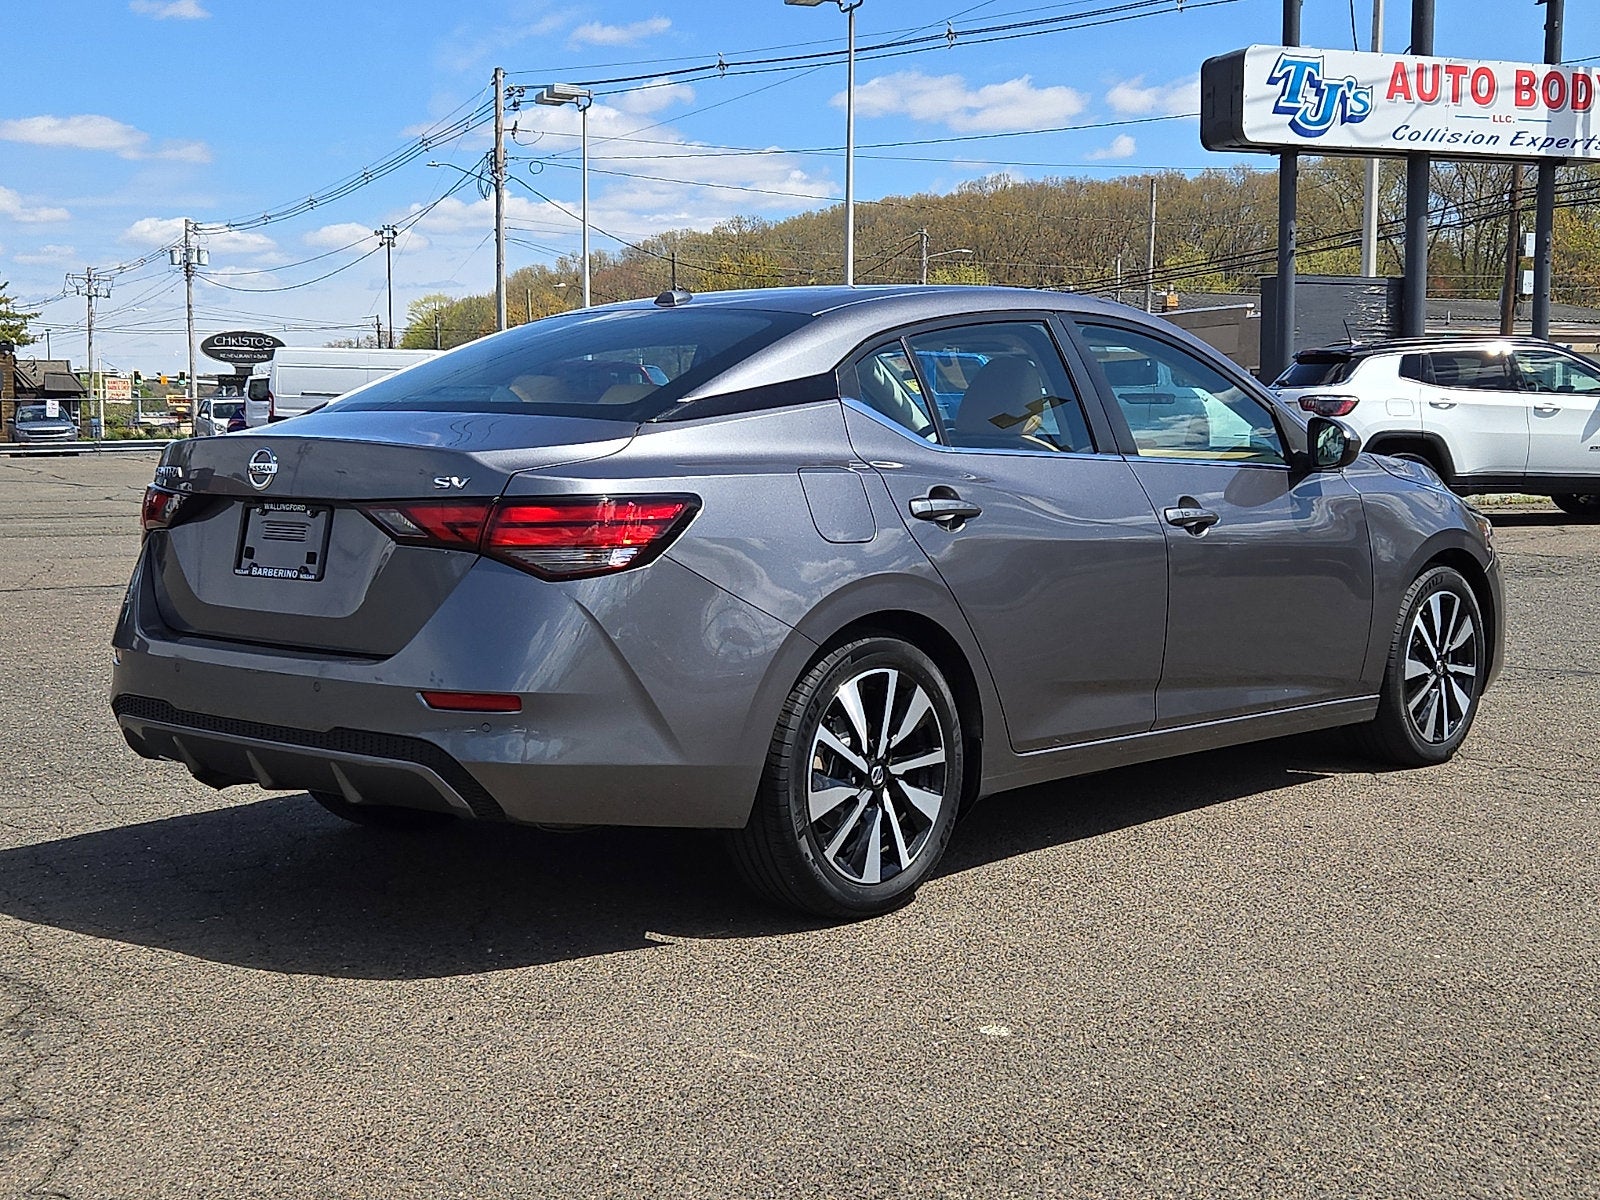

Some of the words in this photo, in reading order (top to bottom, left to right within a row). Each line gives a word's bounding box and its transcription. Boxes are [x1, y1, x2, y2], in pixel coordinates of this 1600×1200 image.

[1266, 52, 1373, 138] TJ's
[1385, 61, 1497, 108] AUTO
[1514, 69, 1600, 112] BOD
[1492, 114, 1515, 124] LLC.
[1391, 124, 1500, 147] Collision
[213, 336, 274, 347] CHRISTOS
[433, 476, 471, 489] SV
[264, 503, 306, 512] WALLINGFORD
[251, 566, 299, 579] BARBERINO
